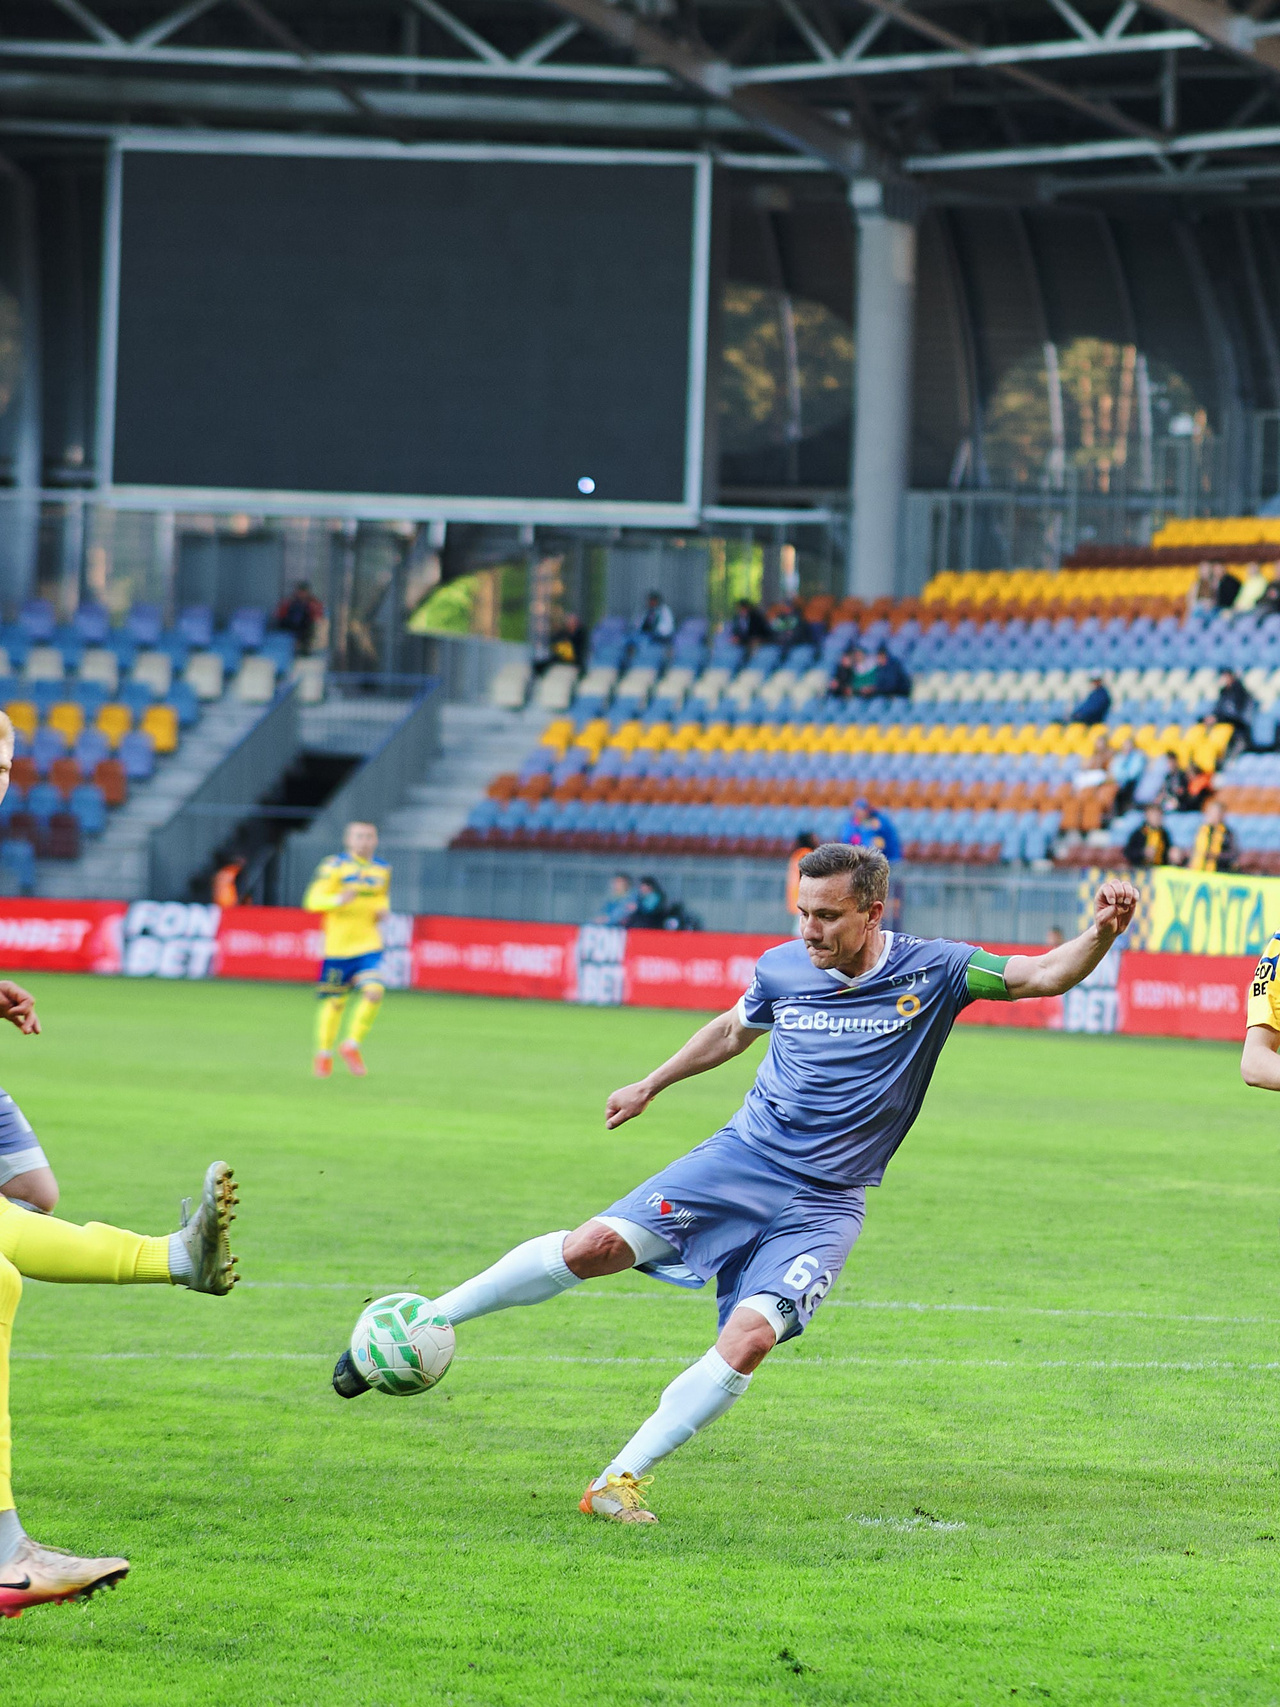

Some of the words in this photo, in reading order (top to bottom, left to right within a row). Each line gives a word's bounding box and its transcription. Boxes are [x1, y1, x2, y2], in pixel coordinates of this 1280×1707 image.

[129, 901, 221, 938] FON
[126, 938, 217, 979] BET
[776, 1297, 794, 1319] 62
